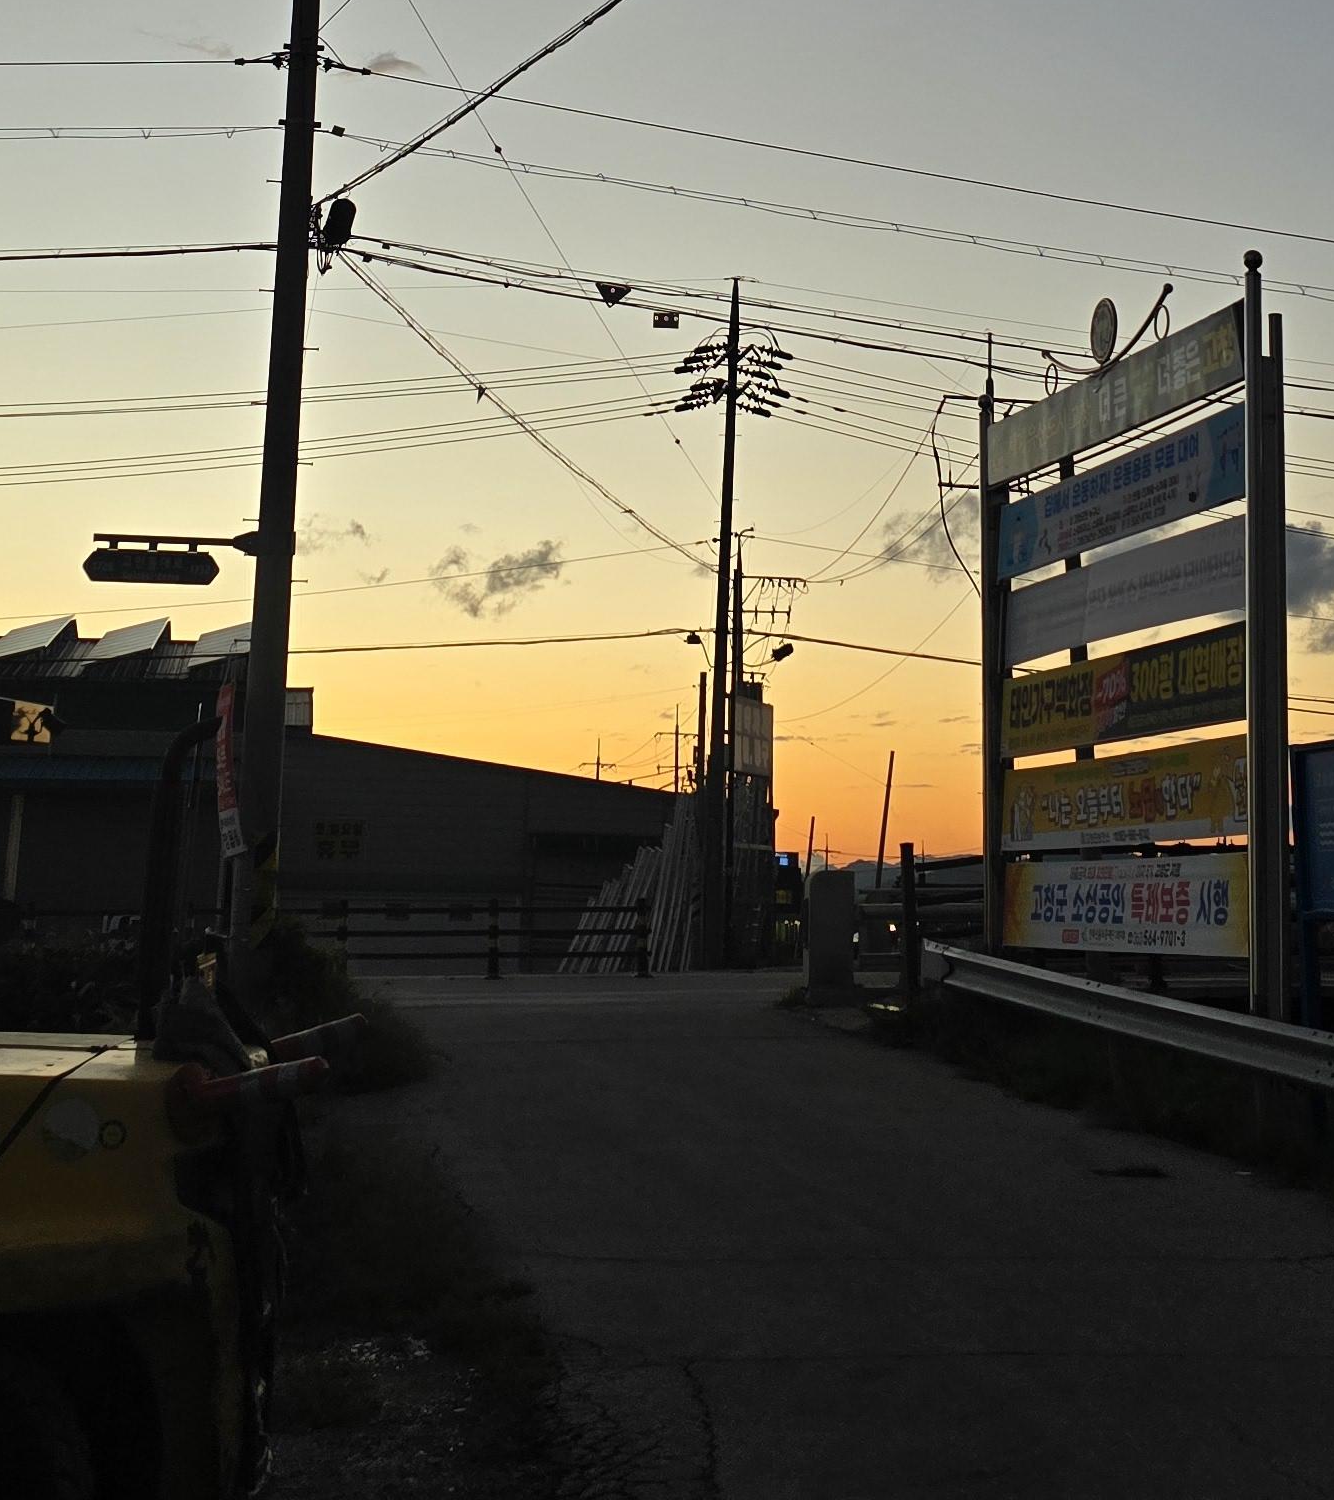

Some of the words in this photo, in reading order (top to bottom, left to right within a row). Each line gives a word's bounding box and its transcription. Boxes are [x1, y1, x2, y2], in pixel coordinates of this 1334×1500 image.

[1154, 444, 1176, 474] 무료
[1178, 431, 1199, 463] 대여
[1178, 632, 1245, 695] 대형매장
[1076, 782, 1127, 827] 오늘부터
[1030, 883, 1067, 923] 고창군
[1071, 883, 1126, 924] 소상공인
[1131, 881, 1190, 925] 특례보증
[1196, 879, 1230, 926] 시행
